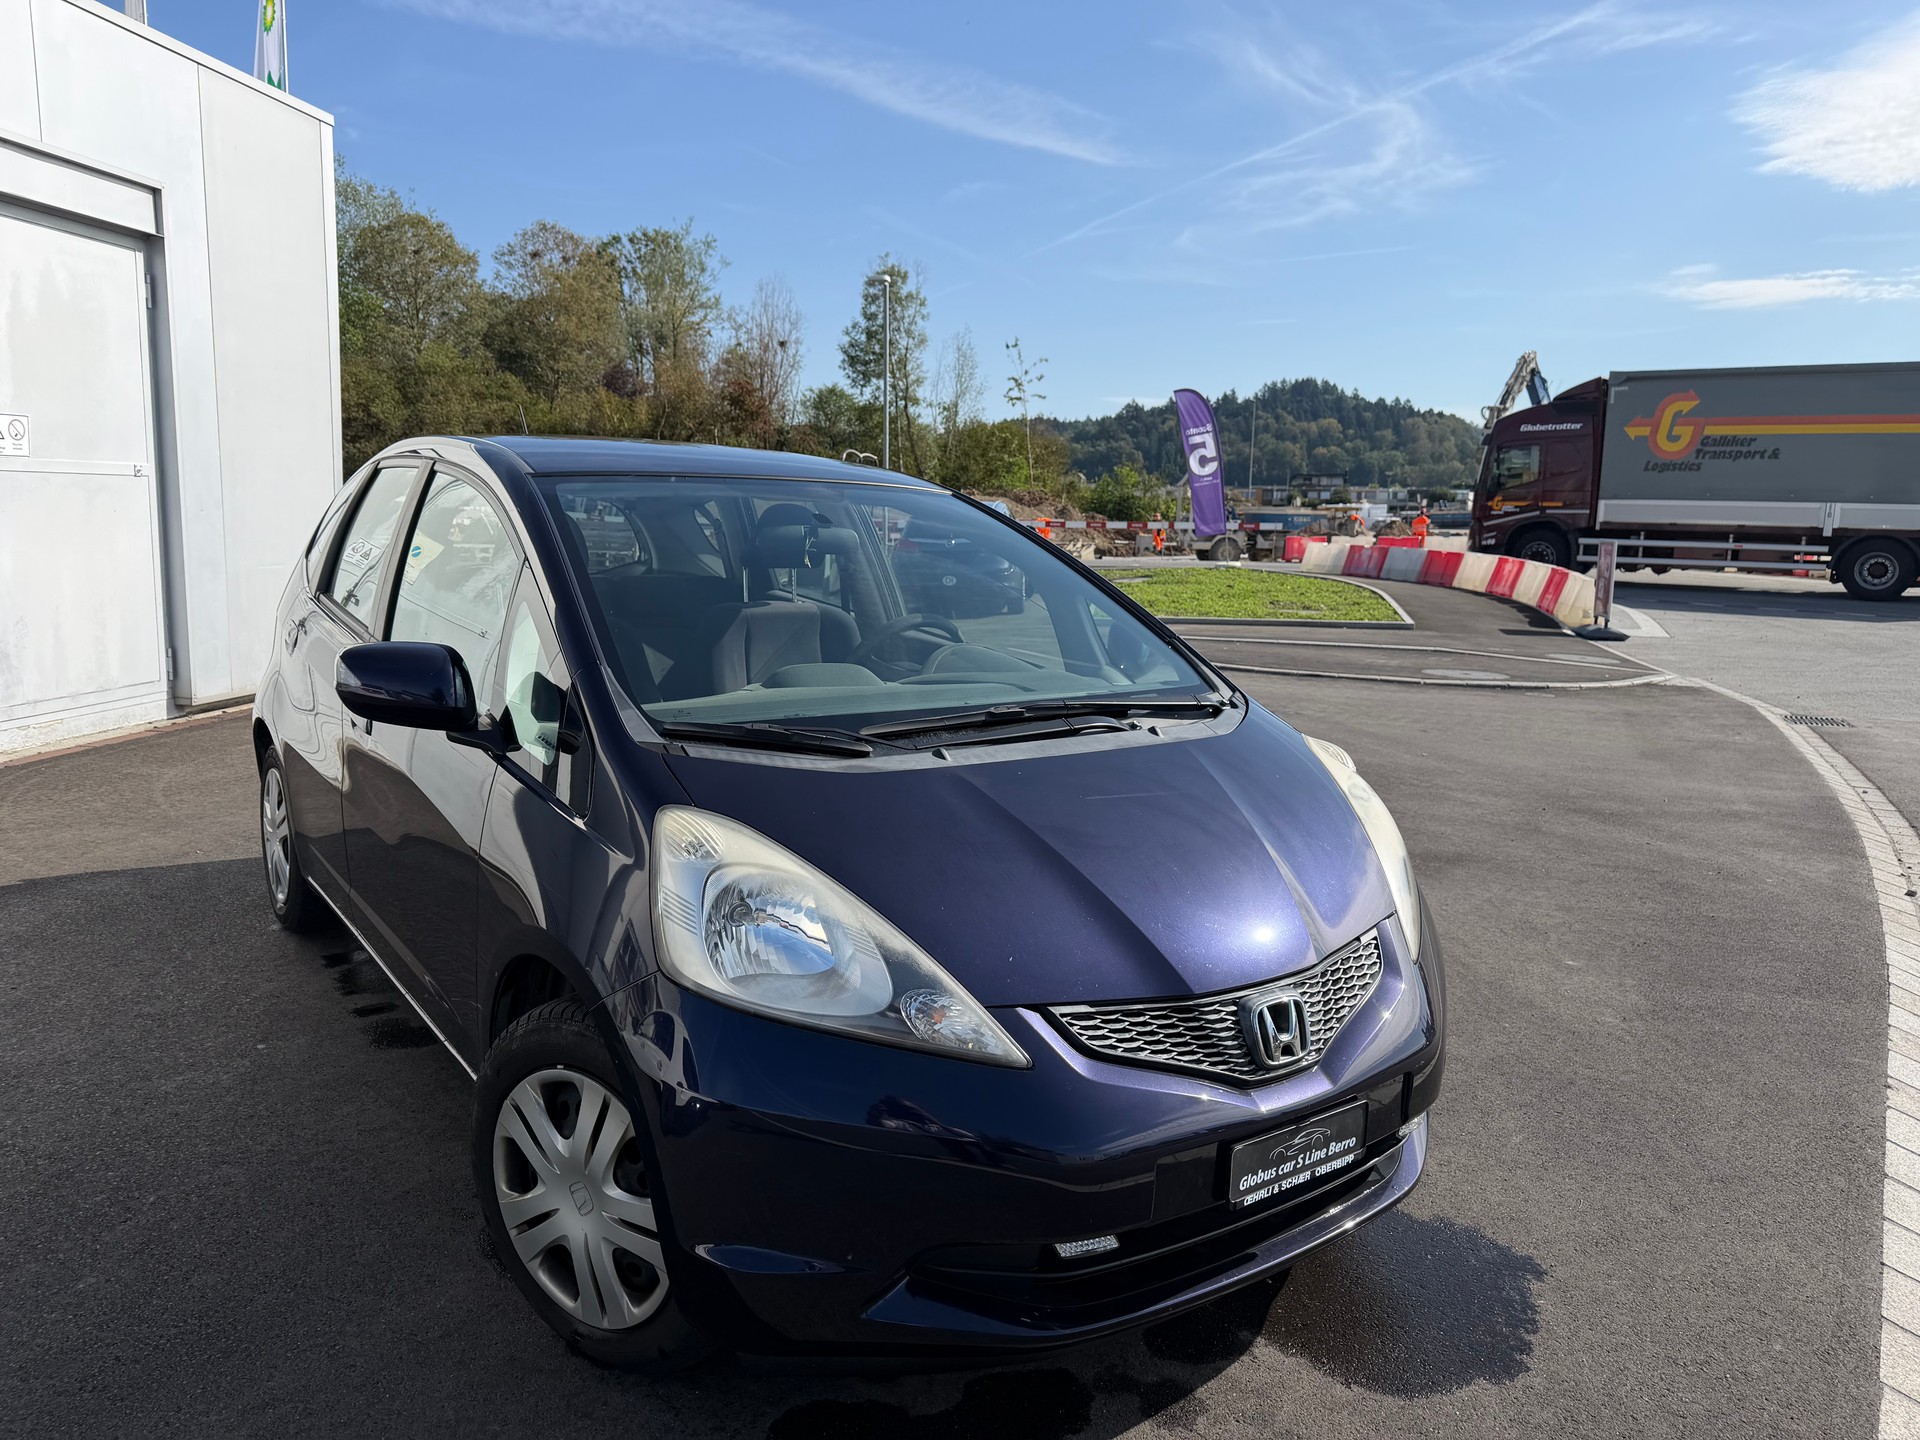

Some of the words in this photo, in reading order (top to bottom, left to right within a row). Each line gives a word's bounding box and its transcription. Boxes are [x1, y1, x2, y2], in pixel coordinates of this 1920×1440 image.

[1520, 422, 1583, 432] Globetrotter
[1700, 435, 1757, 447] Galliker
[1694, 448, 1765, 461] Transport
[1767, 447, 1780, 460] &
[1643, 460, 1702, 473] Logistics
[1239, 1167, 1277, 1191] Globus
[1278, 1160, 1297, 1175] car
[1296, 1154, 1305, 1169] S
[1305, 1148, 1327, 1165] Line
[1327, 1136, 1357, 1156] Berro
[1273, 1184, 1280, 1195] &
[1315, 1154, 1355, 1177] OBERBIPP
